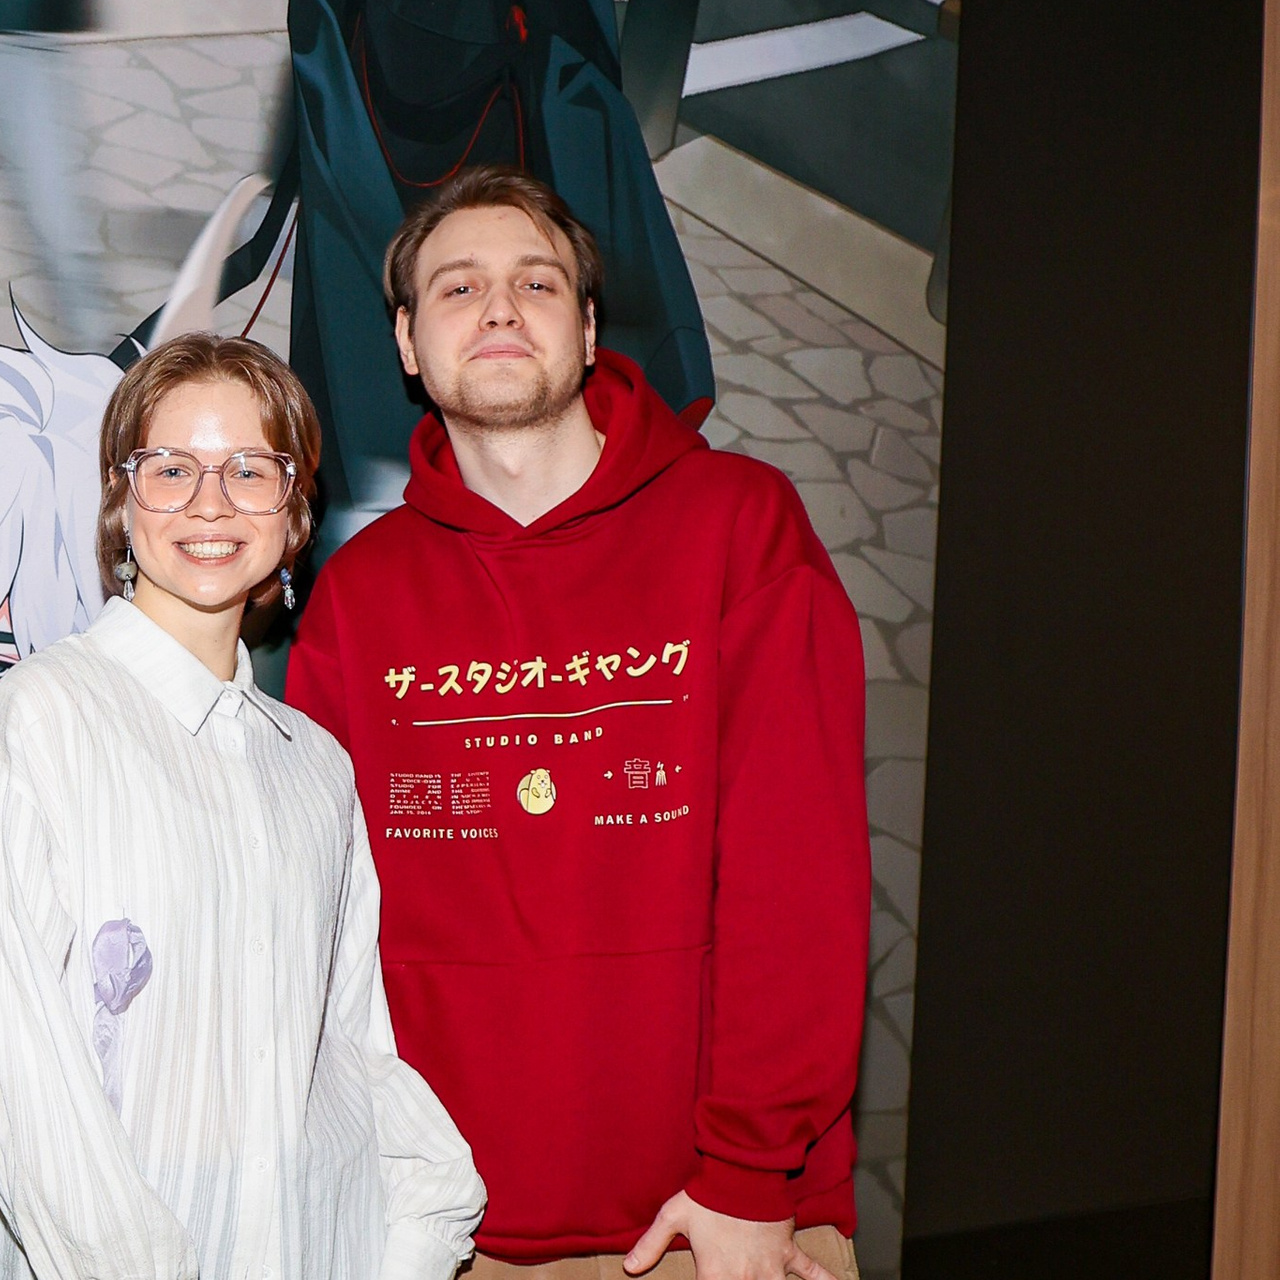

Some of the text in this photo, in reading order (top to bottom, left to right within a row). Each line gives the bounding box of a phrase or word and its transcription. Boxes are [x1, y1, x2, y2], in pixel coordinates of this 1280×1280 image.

[464, 726, 604, 749] STUDIO BAND
[594, 804, 690, 826] MAKE A SOUND
[385, 827, 499, 839] FAVORITE VOICES
